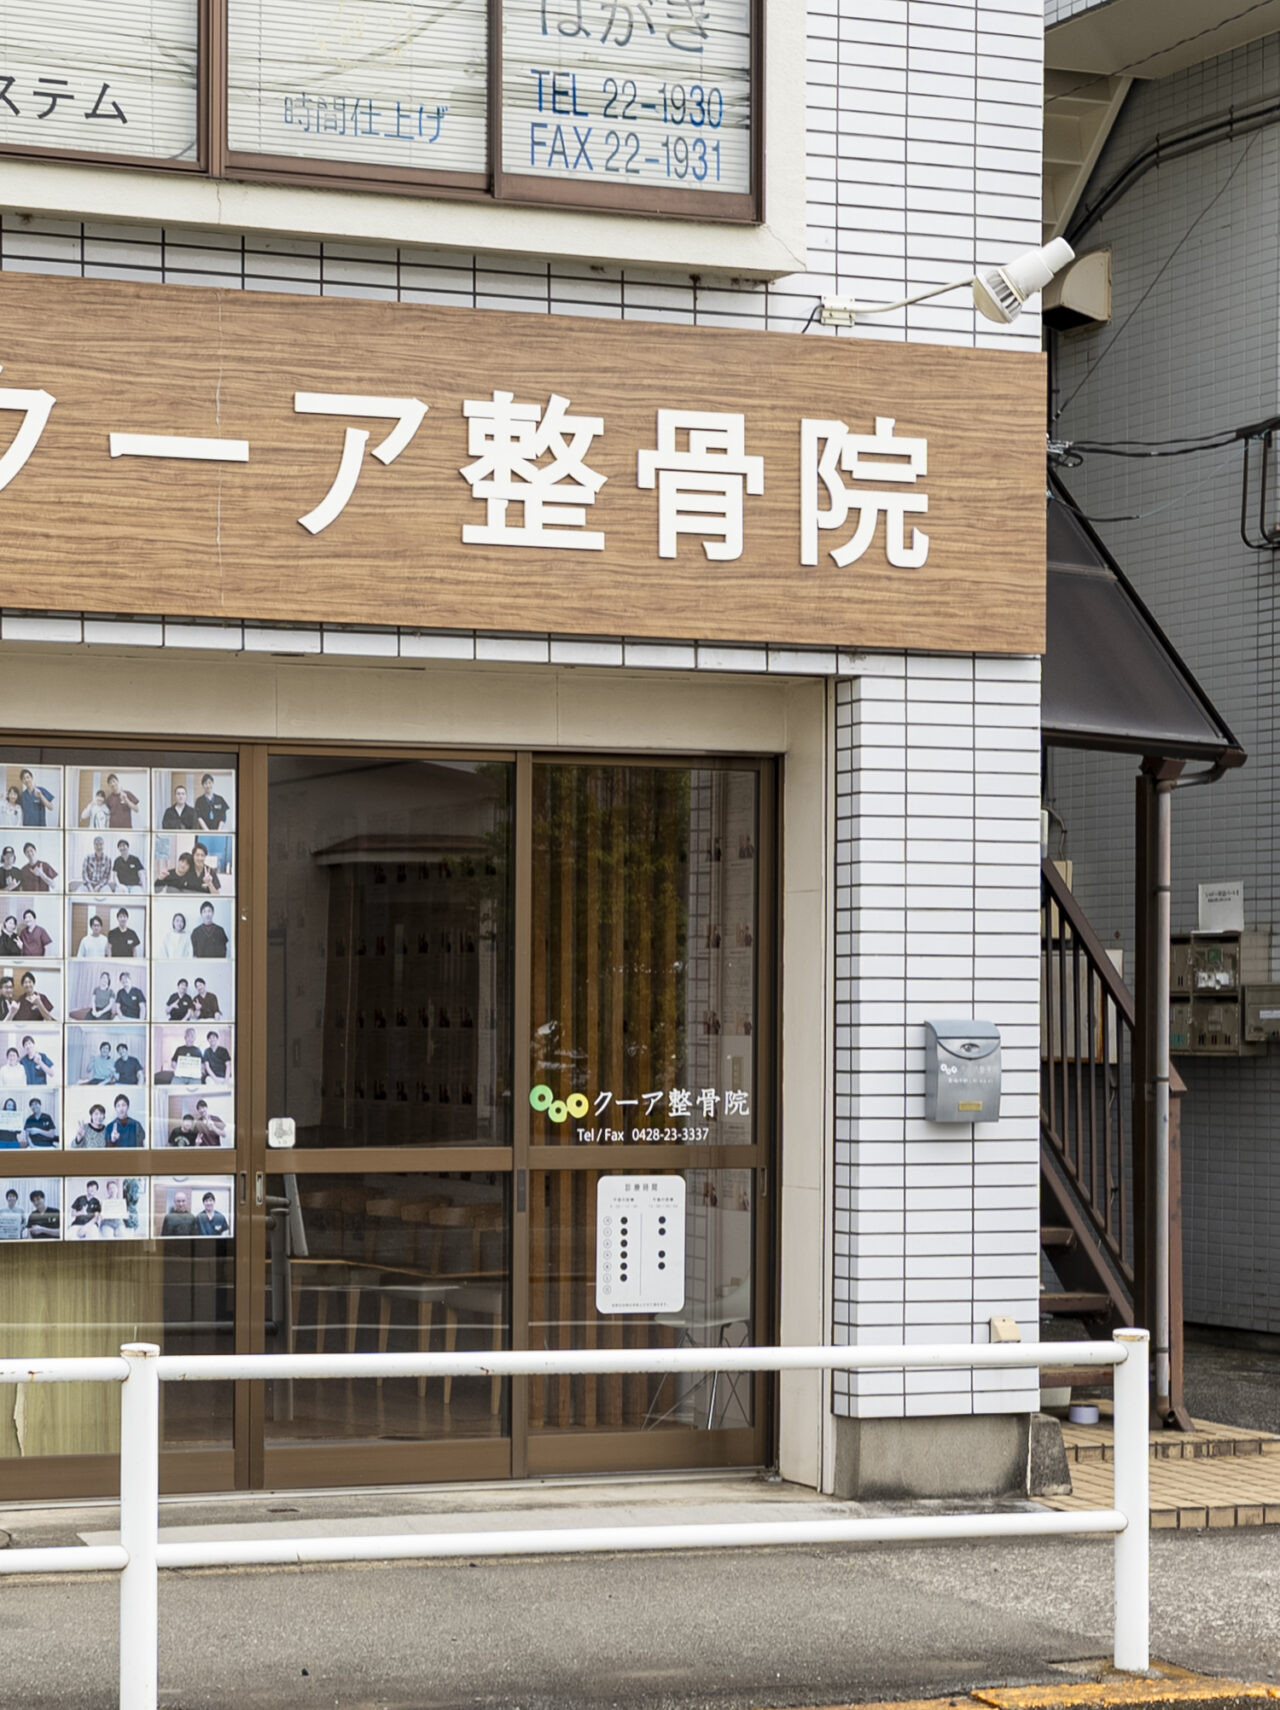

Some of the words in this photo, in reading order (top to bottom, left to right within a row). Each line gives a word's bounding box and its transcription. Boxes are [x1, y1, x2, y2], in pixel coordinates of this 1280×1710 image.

[283, 91, 448, 144] 時間仕上げ
[530, 68, 589, 118] TEL
[602, 77, 723, 130] 22-1930
[530, 122, 593, 171] FAX
[604, 130, 722, 182] 22-1931
[593, 1088, 750, 1118] クーア整骨院
[631, 1127, 710, 1142] 0428-23-3337
